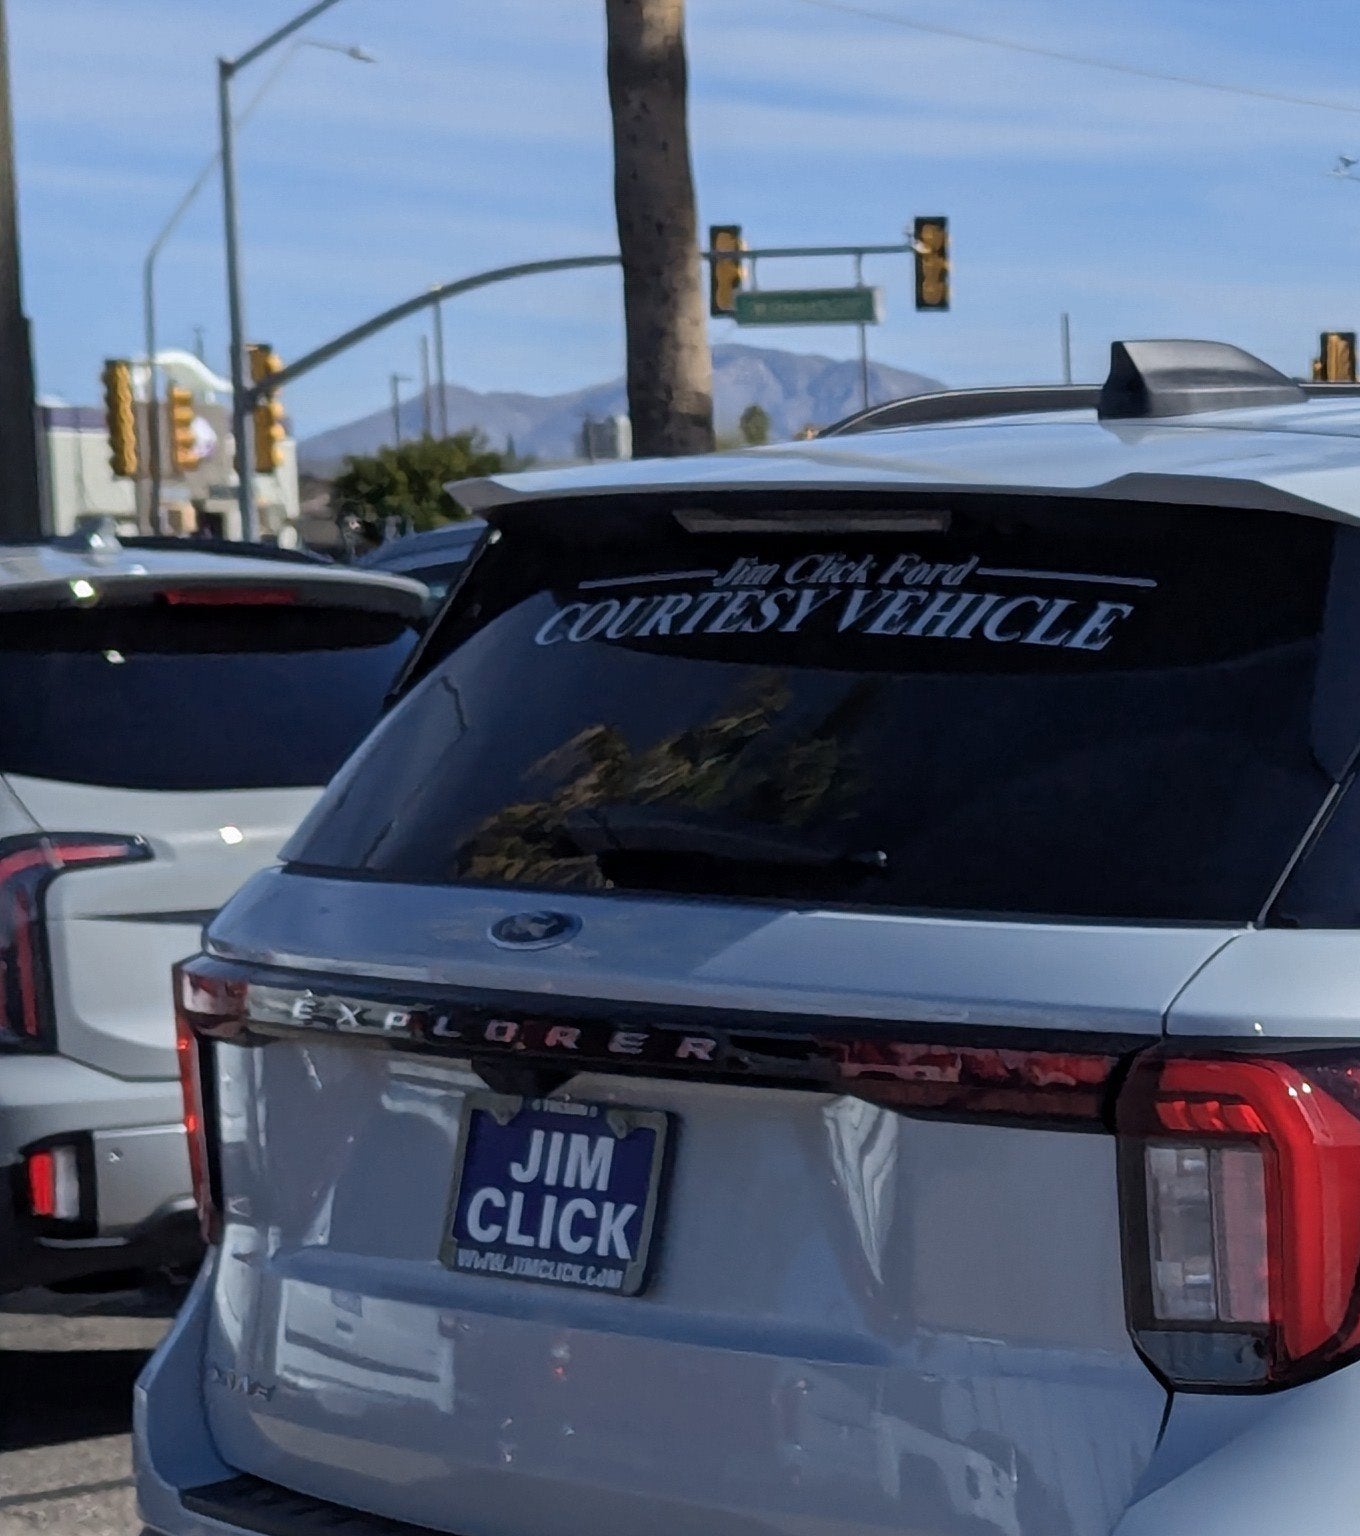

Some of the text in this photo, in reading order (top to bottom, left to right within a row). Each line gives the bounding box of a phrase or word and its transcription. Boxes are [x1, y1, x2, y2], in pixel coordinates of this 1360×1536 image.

[712, 554, 980, 587] Jim Click Ford
[534, 589, 1134, 652] COURTESY VEHICLE
[292, 990, 718, 1062] EXPLORER
[510, 1129, 616, 1192] JIM
[467, 1187, 639, 1260] CLICK
